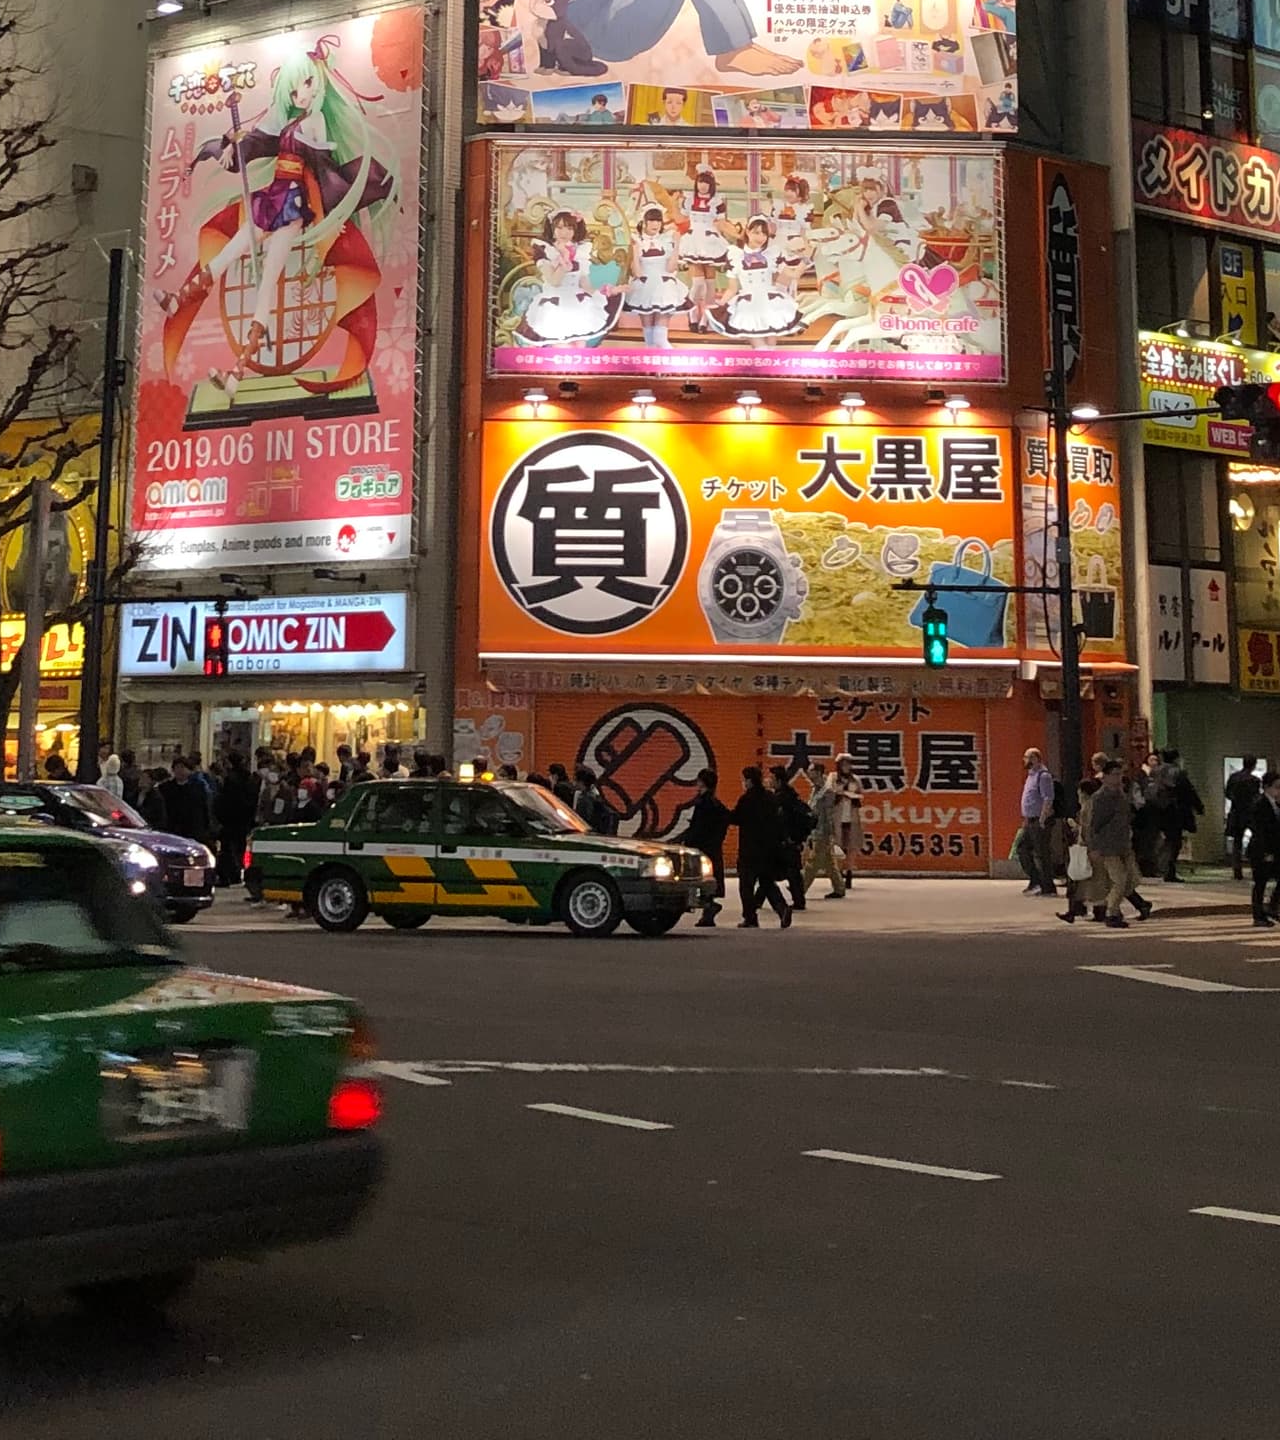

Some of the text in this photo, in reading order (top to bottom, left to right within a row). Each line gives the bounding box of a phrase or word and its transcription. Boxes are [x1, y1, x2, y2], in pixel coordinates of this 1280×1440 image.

[155, 127, 182, 277] ムラサメ
[1224, 252, 1242, 273] 3F
[879, 315, 979, 333] @home cafe
[1145, 344, 1243, 388] 全身もみほぐし
[147, 419, 402, 472] 2019.06 IN STORE
[1025, 435, 1115, 487] 質買取
[335, 472, 402, 502] フィギュア
[797, 434, 1005, 504] 大黒屋
[146, 476, 229, 509] amiami
[700, 475, 786, 501] チケット
[222, 538, 251, 552] Anime
[253, 536, 283, 550] goods
[285, 536, 304, 547] and
[306, 535, 332, 547] more
[514, 462, 665, 609] 質
[131, 605, 197, 670] ZIN
[228, 616, 346, 652] OMIC ZIN
[817, 697, 931, 723] チケット
[768, 729, 982, 793] 大黒屋
[859, 800, 982, 829] okuya
